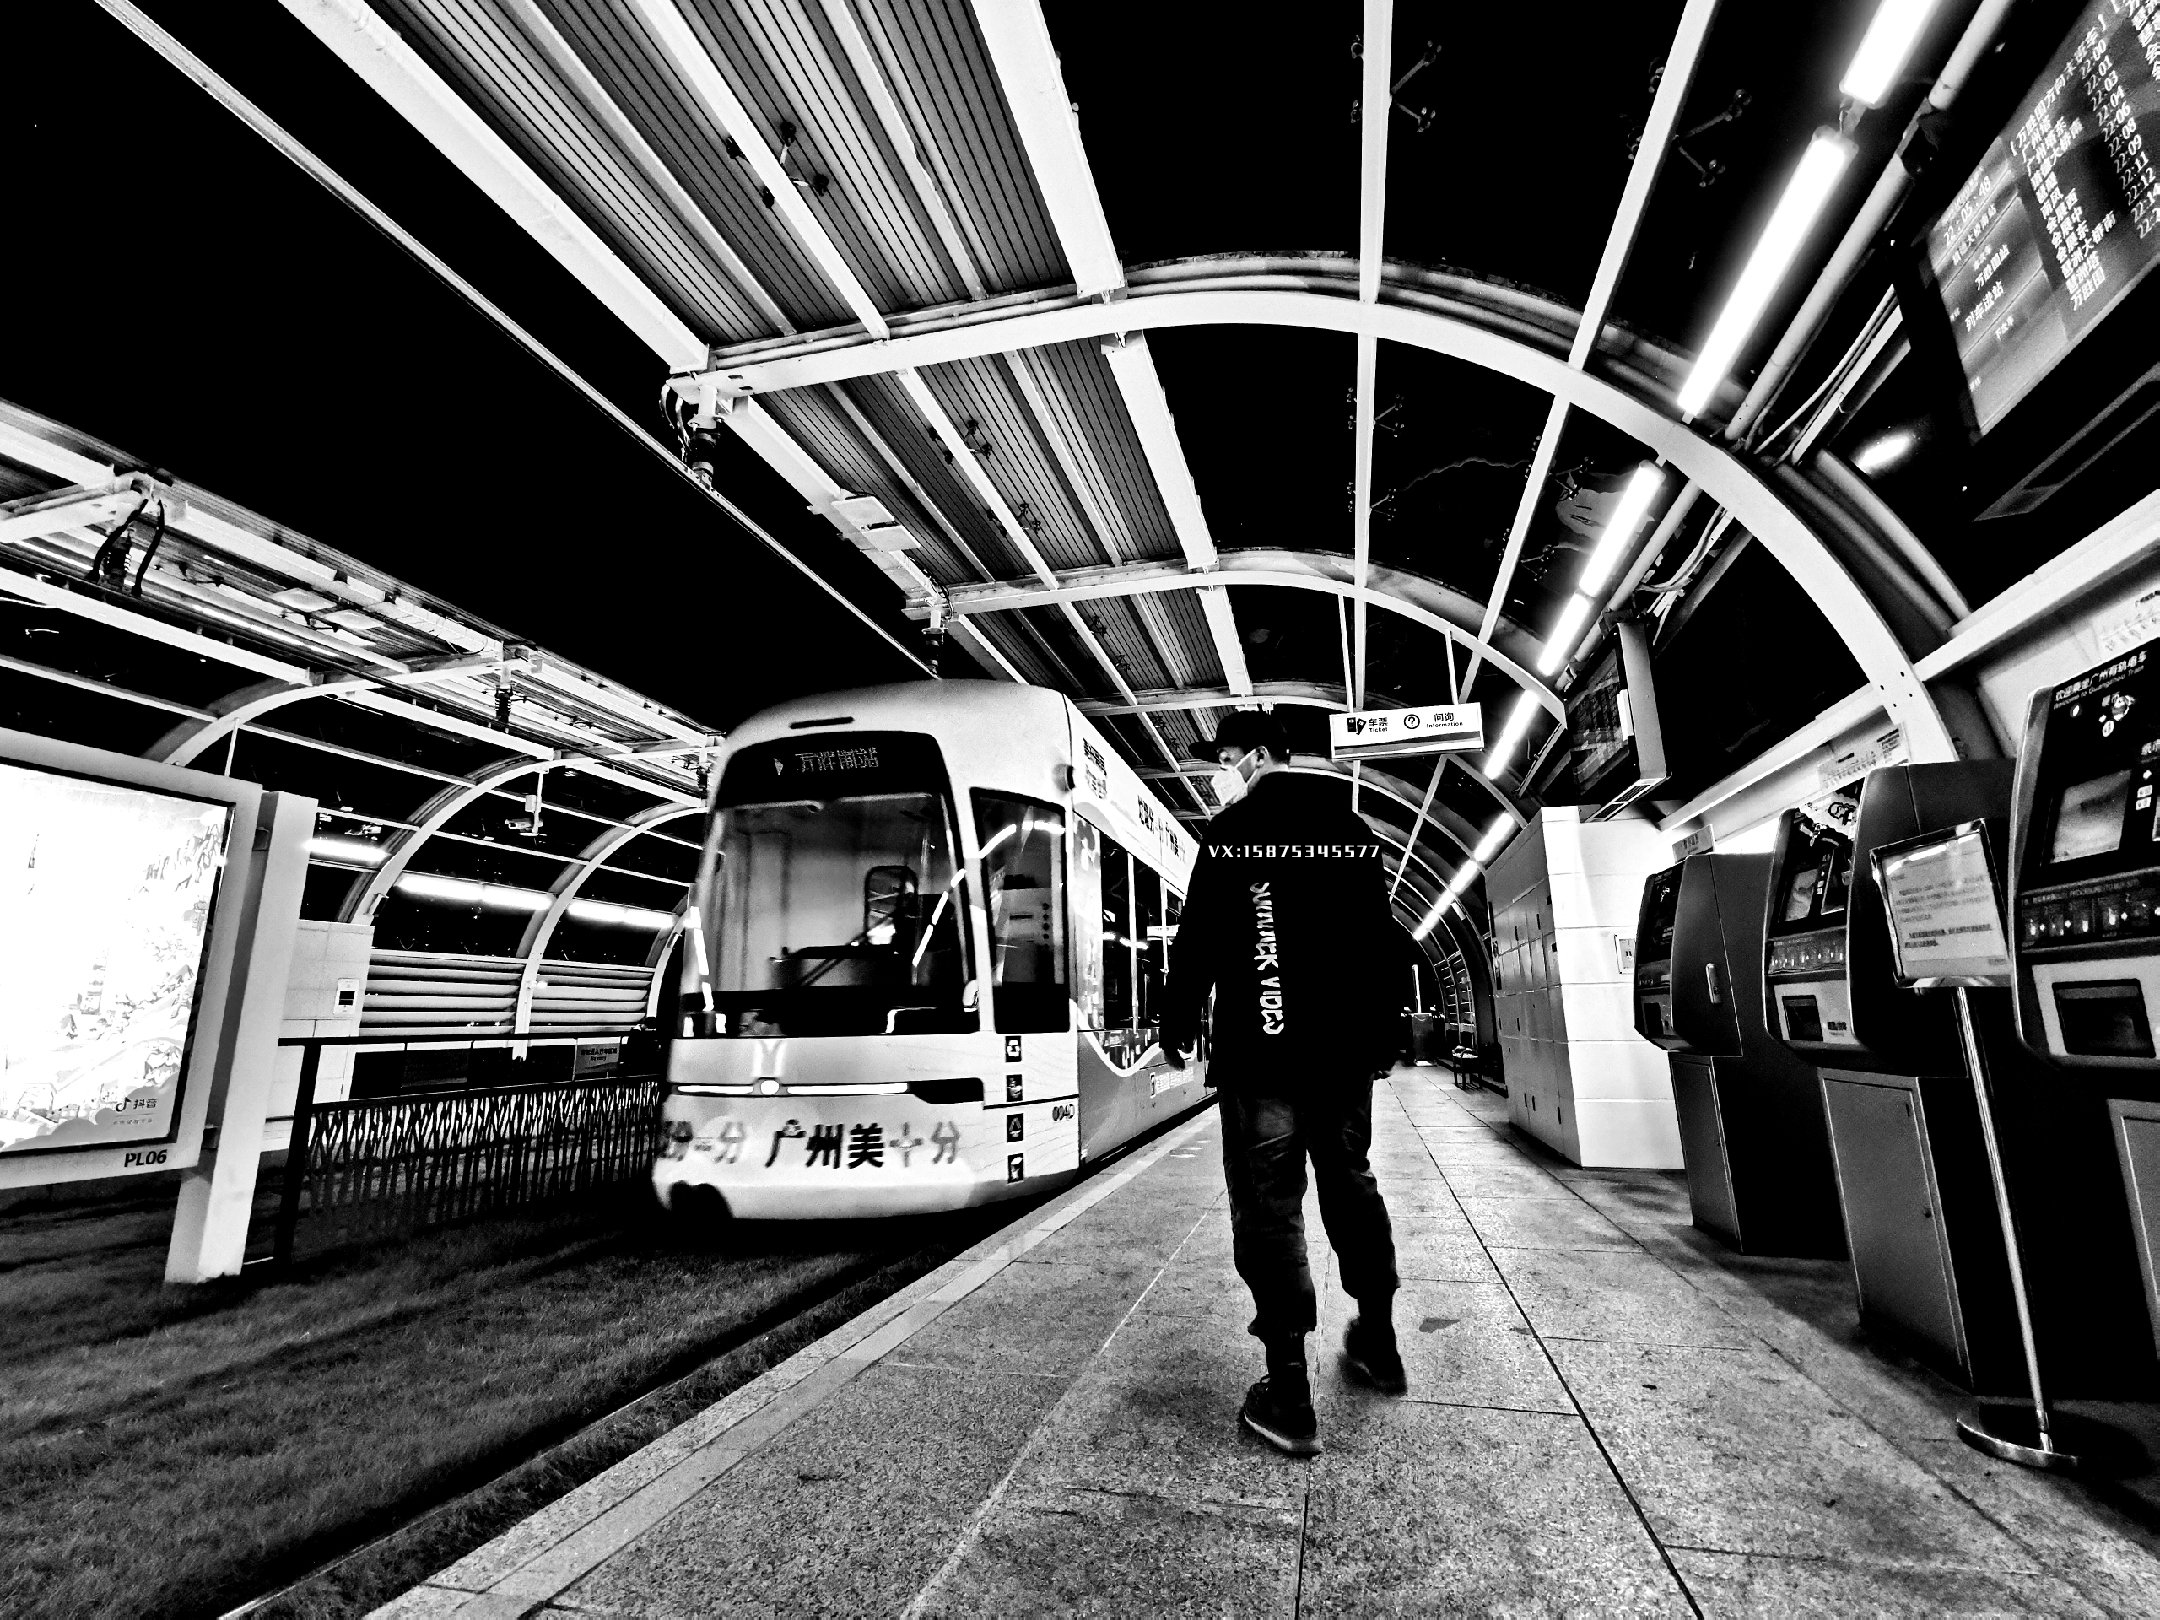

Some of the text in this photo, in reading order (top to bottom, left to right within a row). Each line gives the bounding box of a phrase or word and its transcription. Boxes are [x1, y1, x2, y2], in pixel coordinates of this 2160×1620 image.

[2080, 39, 2106, 79] 22:00
[2085, 55, 2112, 95] 22:01
[2092, 70, 2118, 111] 22:03
[2103, 101, 2130, 142] 22:06
[1368, 712, 1455, 727] 车票 问询
[133, 1099, 157, 1109] 抖音
[124, 1149, 168, 1168] PL06
[765, 1118, 960, 1169] 广州美十分
